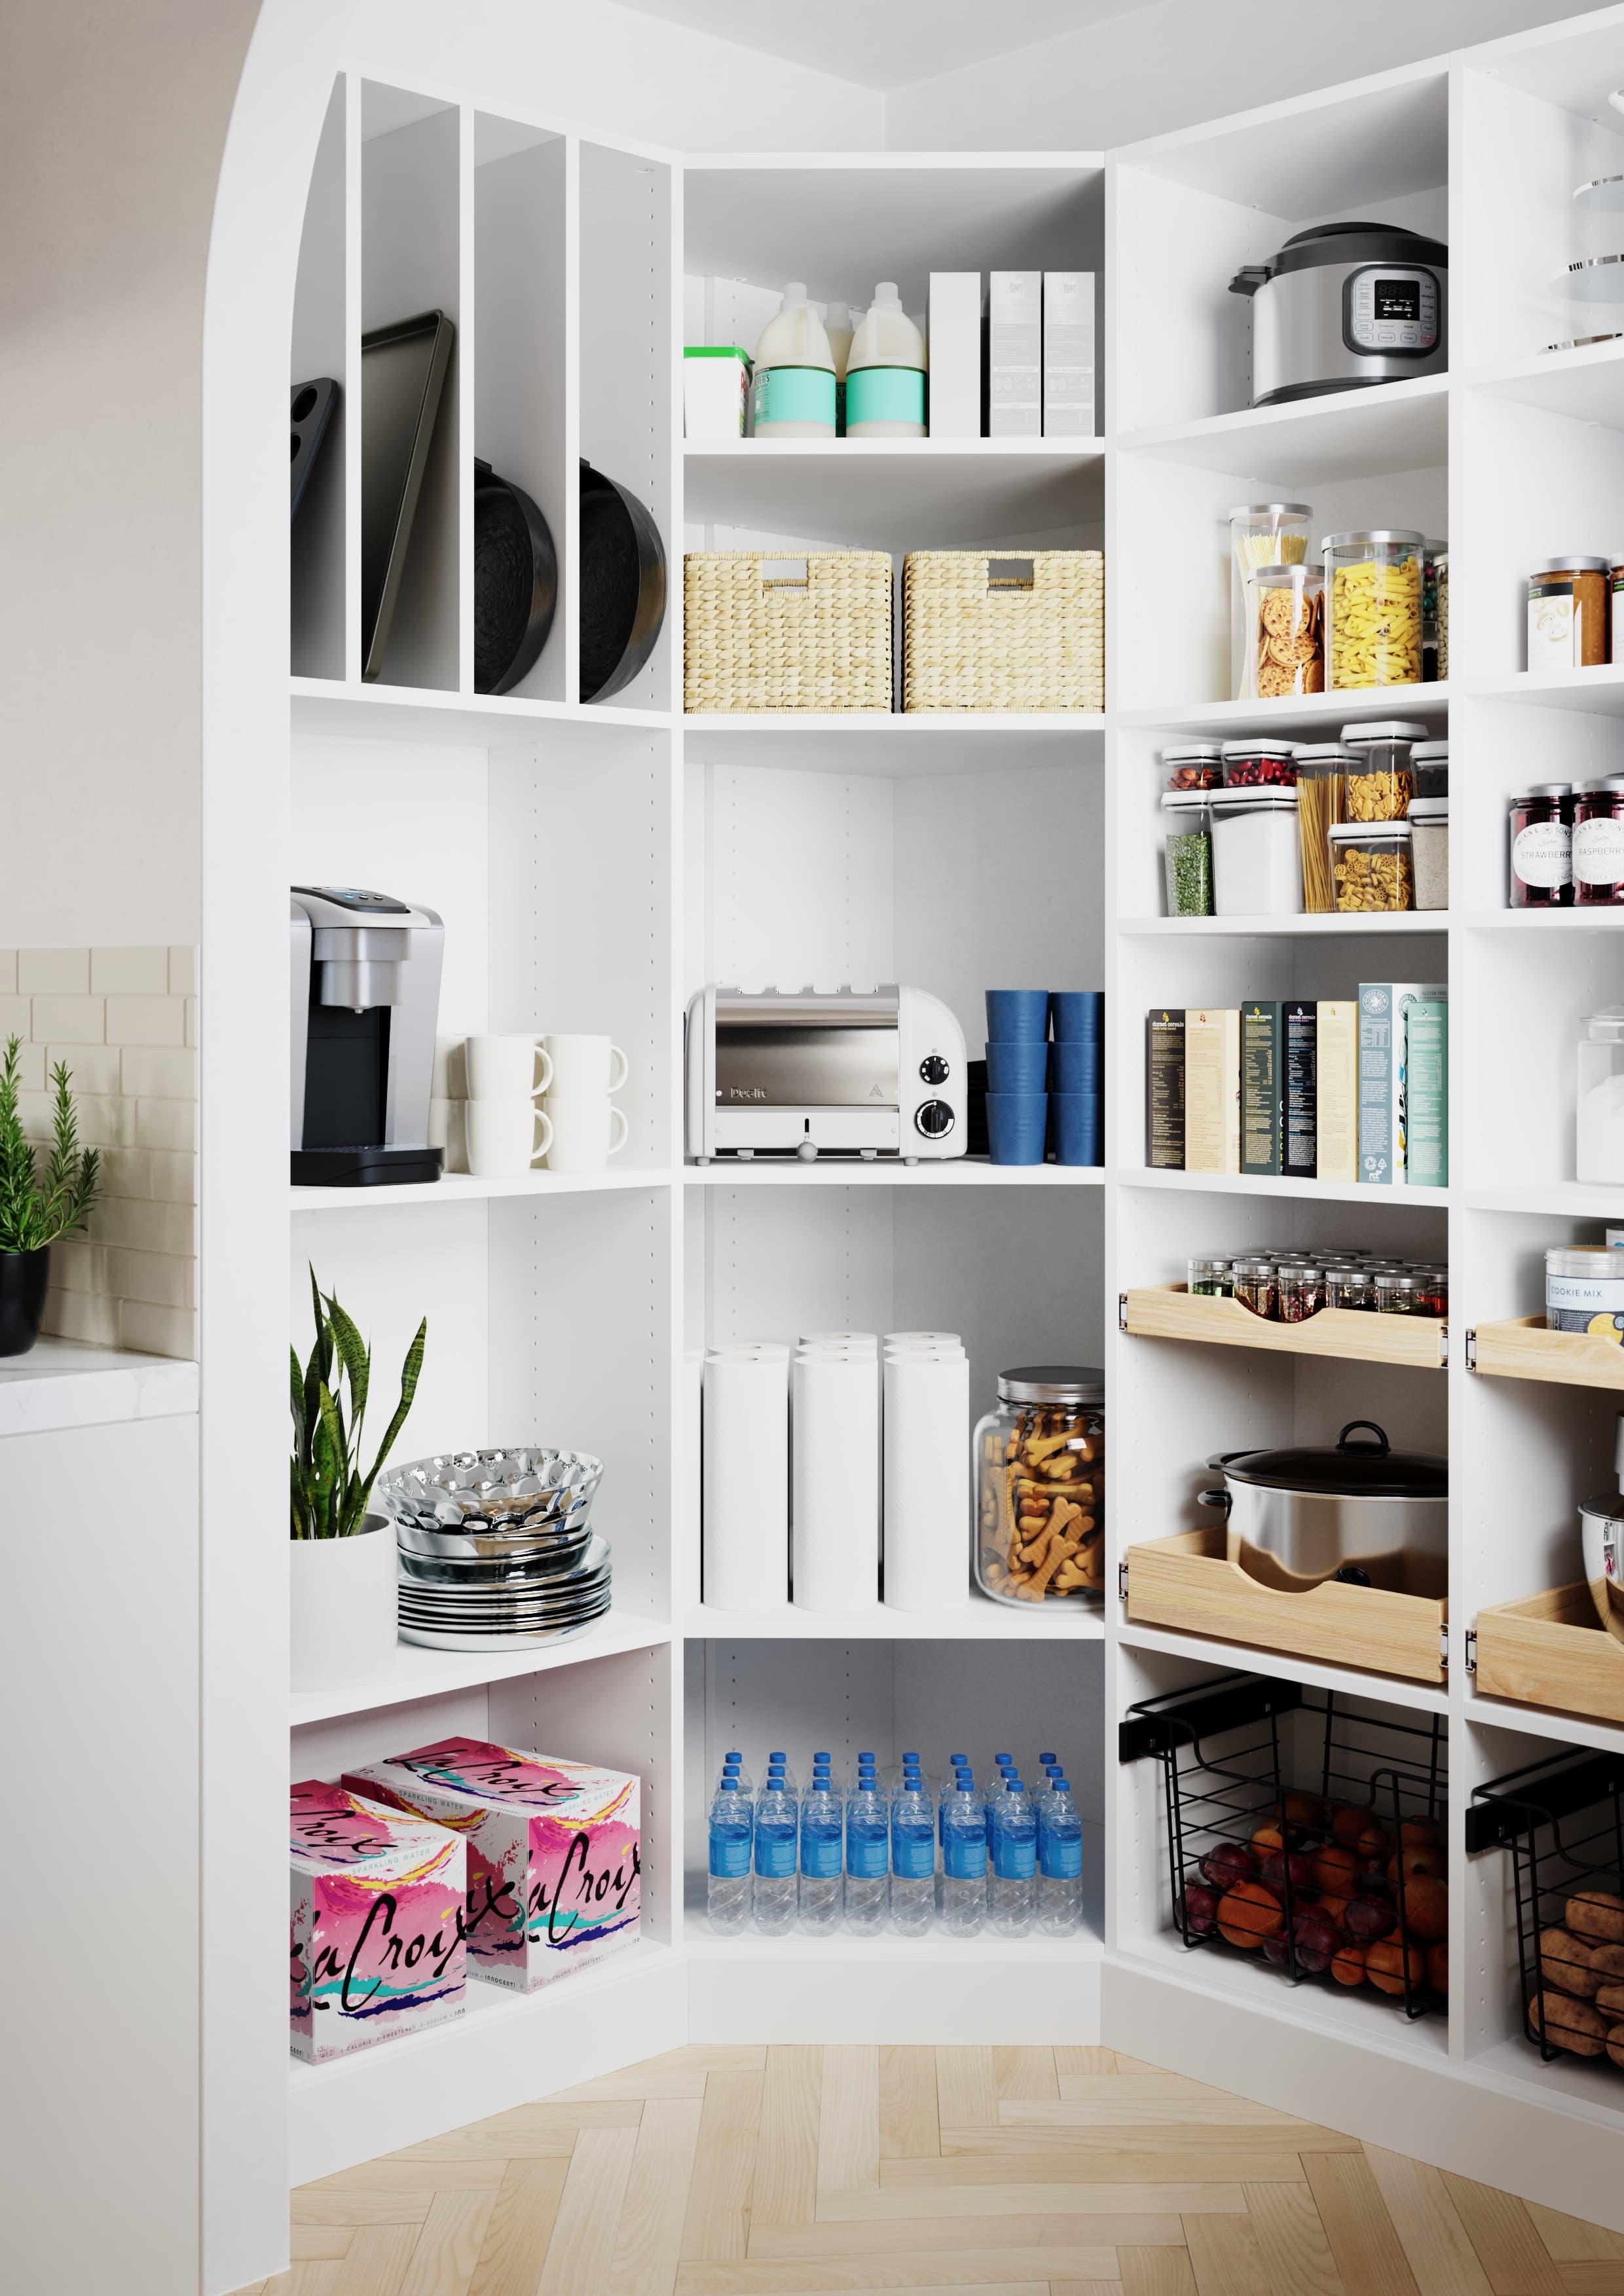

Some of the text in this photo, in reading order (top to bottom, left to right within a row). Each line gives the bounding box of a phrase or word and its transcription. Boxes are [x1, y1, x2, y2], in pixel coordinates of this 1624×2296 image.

[730, 1086, 768, 1099] Dualit
[1550, 1286, 1602, 1298] COOKIE MIX
[398, 1790, 464, 1811] SPARKLING WATER
[556, 1789, 614, 1815] SPARKLING WATER
[351, 1848, 431, 1874] SPARKLING WATER
